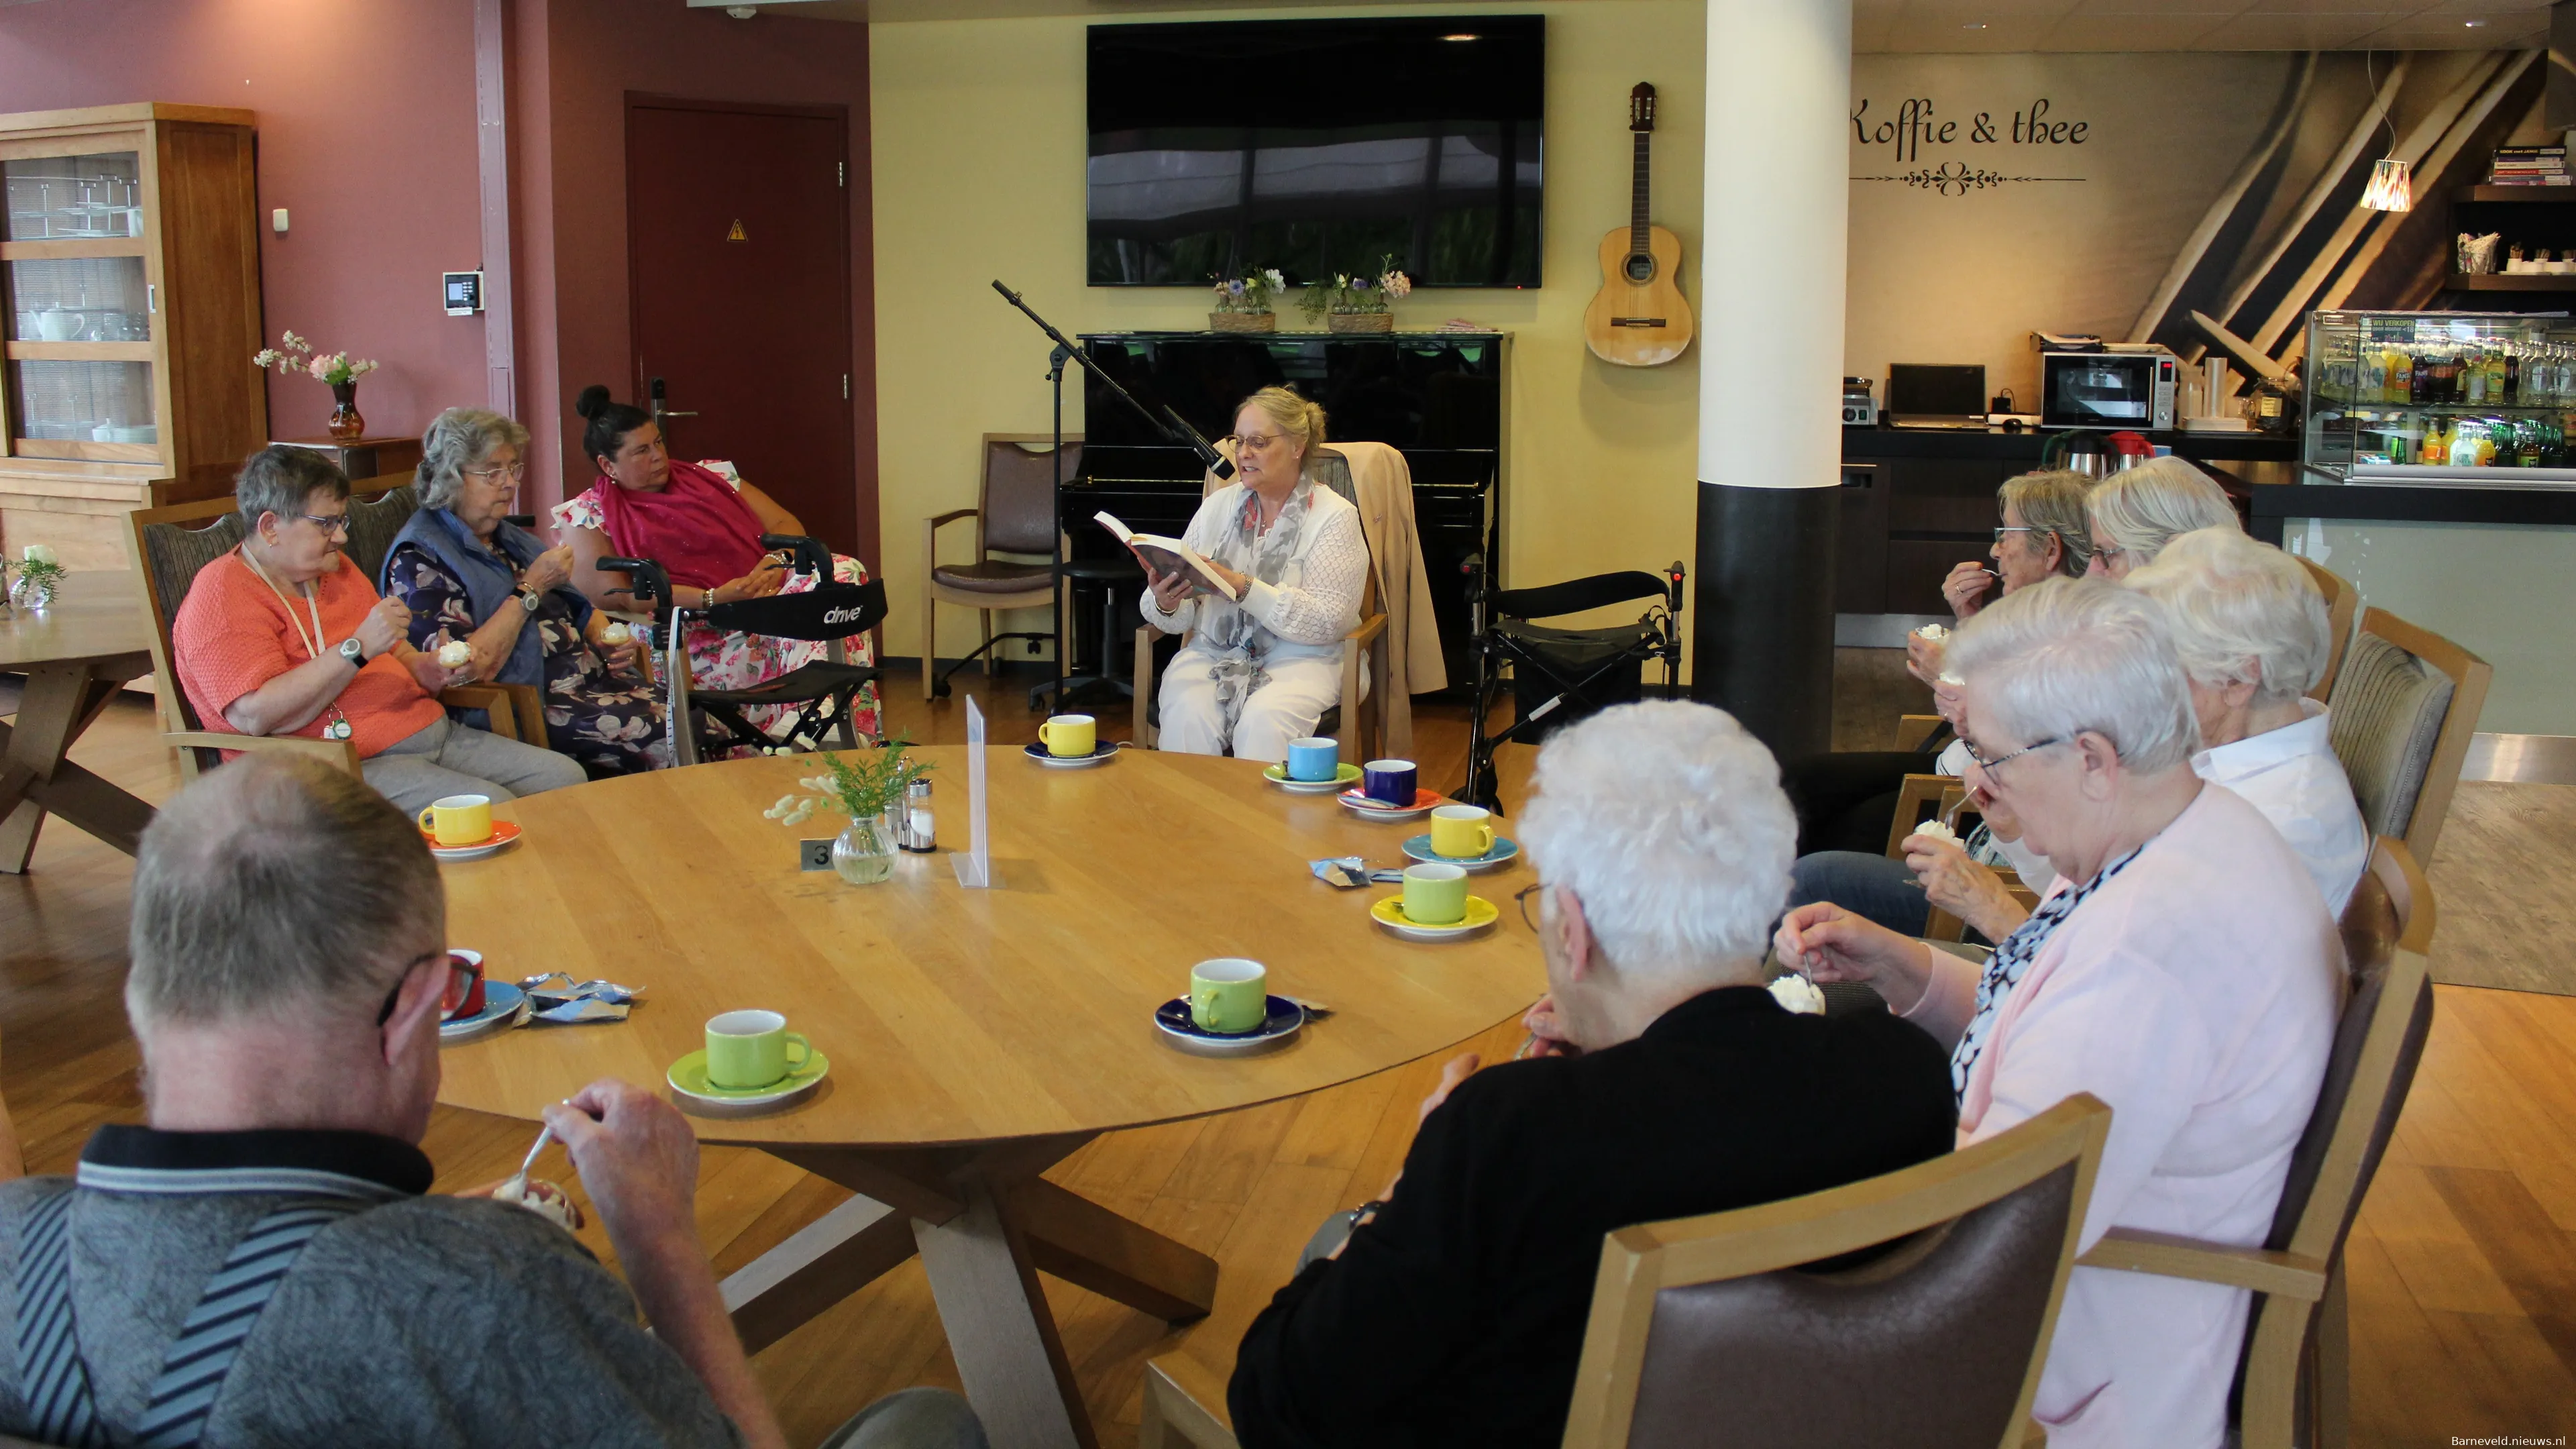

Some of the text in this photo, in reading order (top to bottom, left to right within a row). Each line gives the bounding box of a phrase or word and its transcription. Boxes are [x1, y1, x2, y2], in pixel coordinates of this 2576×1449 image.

[1850, 98, 2090, 162] Koffie & thee
[824, 606, 861, 624] drive
[814, 845, 829, 865] 3
